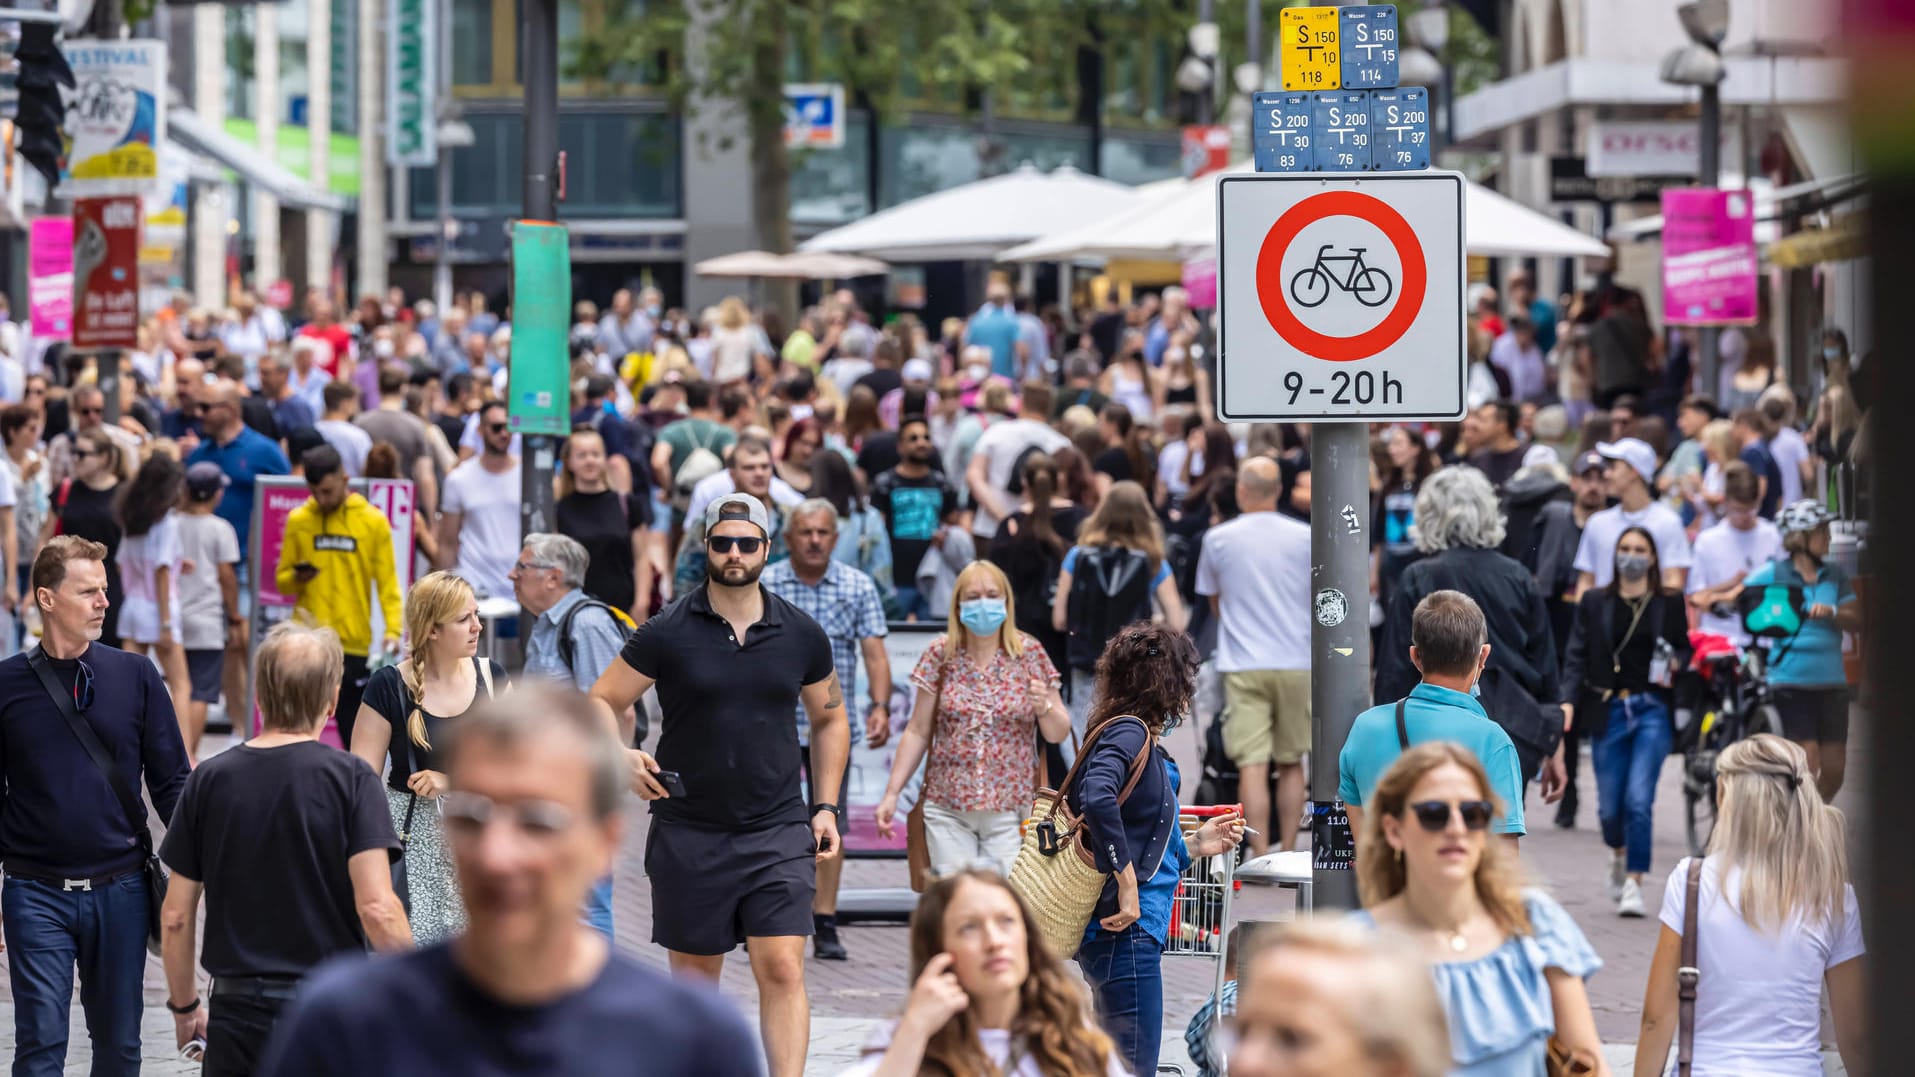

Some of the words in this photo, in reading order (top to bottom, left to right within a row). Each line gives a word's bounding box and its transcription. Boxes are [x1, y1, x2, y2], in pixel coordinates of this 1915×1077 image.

[1298, 24, 1309, 43] S
[1315, 31, 1336, 43] 150
[1356, 23, 1368, 42] S
[1374, 29, 1394, 42] 150
[66, 48, 149, 66] ESTIVAL
[1271, 109, 1282, 128] S
[1286, 115, 1308, 128] 200
[1330, 107, 1340, 126] S
[1344, 113, 1367, 126] 200
[1388, 105, 1399, 124] S
[1403, 111, 1425, 124] 200
[1328, 816, 1348, 826] 11.0
